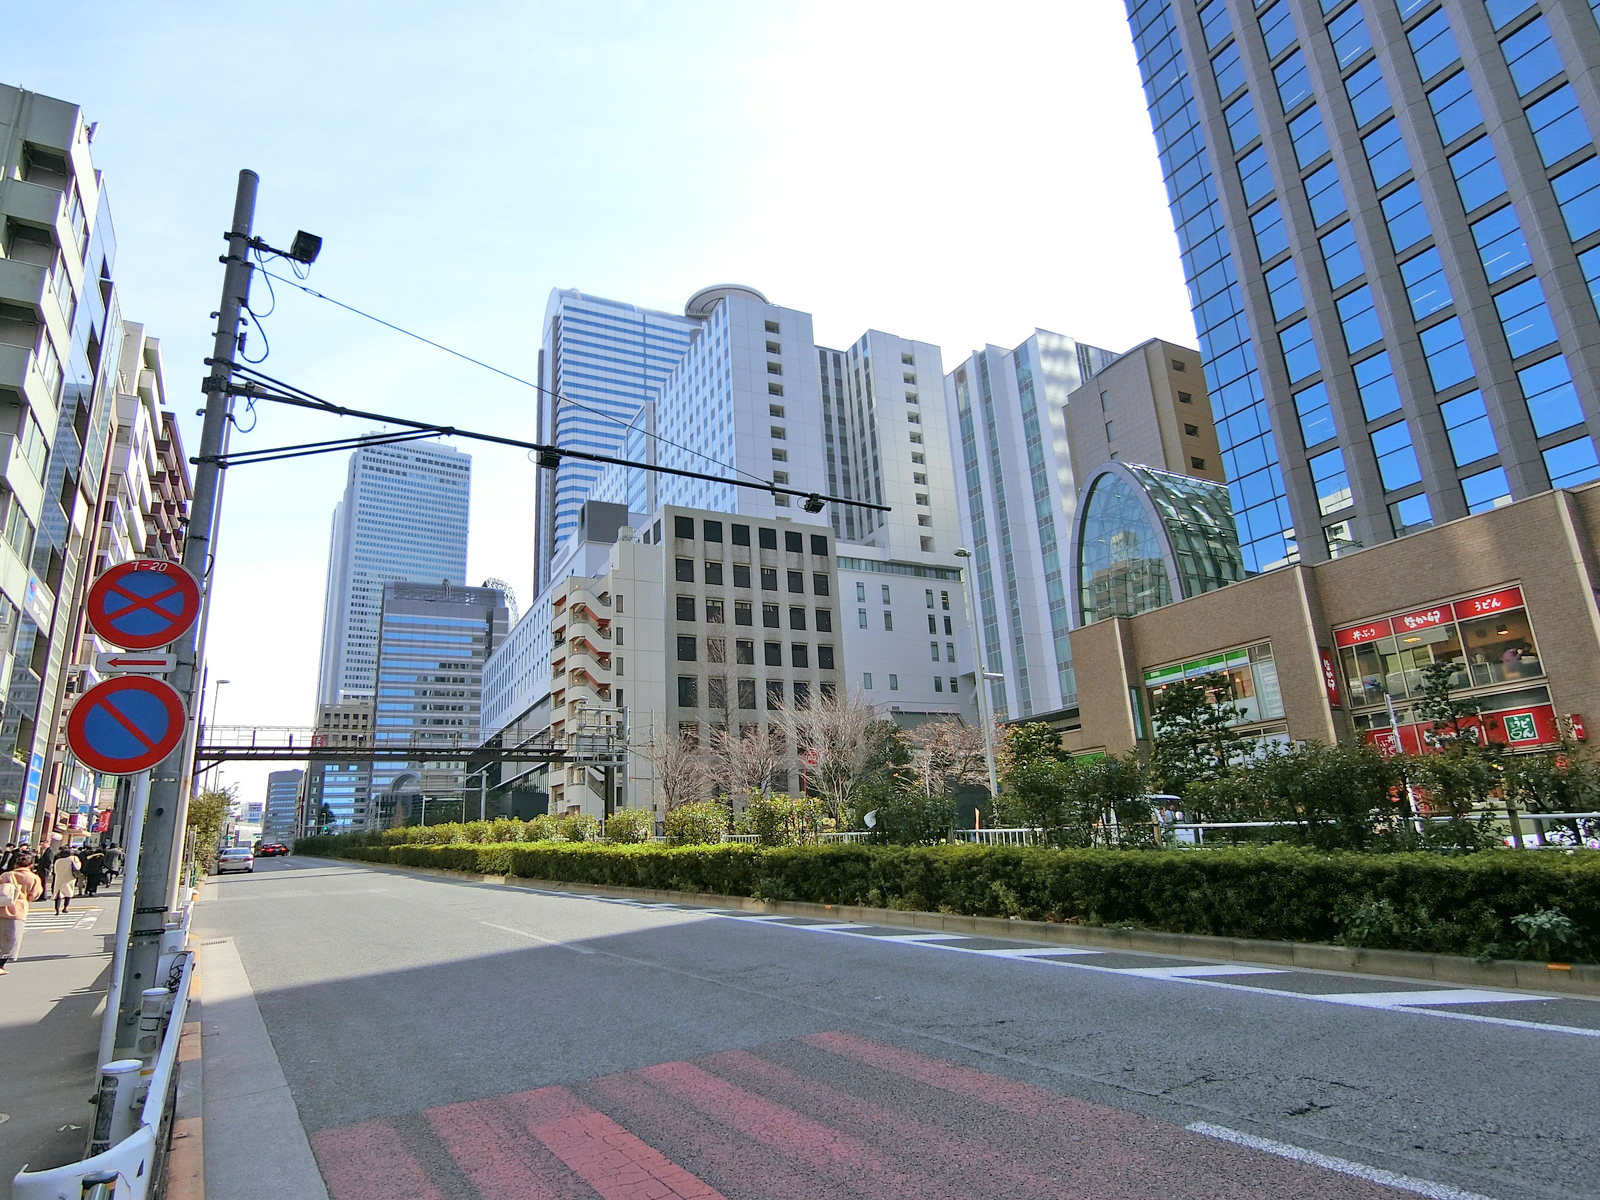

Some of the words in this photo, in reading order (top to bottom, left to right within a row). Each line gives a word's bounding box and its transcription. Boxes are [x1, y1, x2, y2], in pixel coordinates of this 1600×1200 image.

[131, 561, 168, 572] 7-20
[1474, 597, 1502, 612] うどん
[1403, 610, 1441, 629] なか卯
